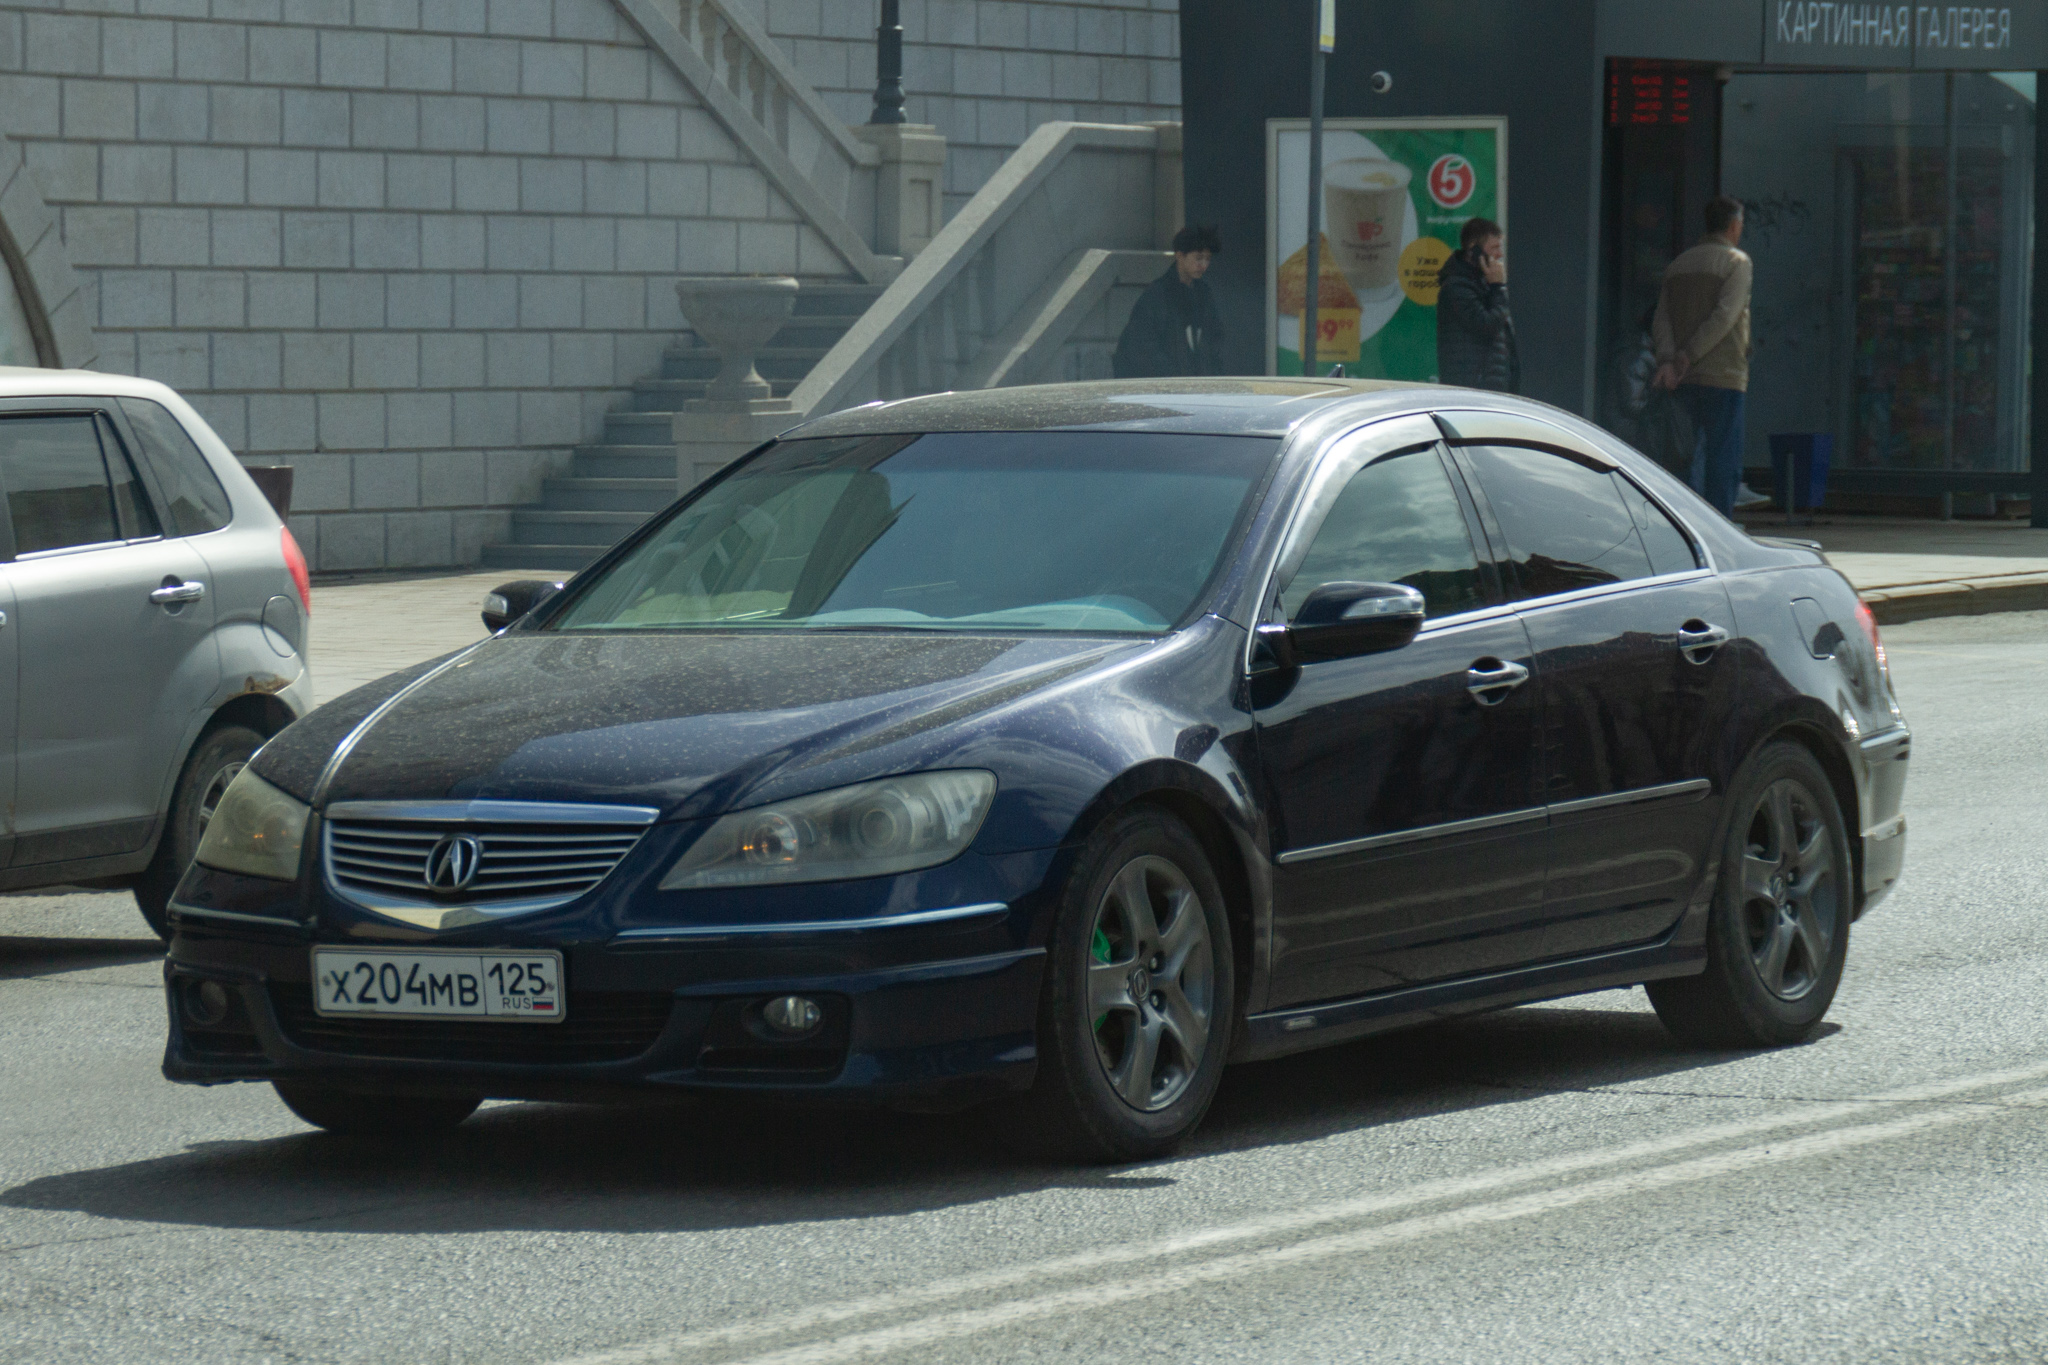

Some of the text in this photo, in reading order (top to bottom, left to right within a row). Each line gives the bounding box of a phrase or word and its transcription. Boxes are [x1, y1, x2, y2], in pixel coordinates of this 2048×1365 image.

[1776, 1, 2011, 49] КАРТИННАЯ ГАЛЕРЕЯ
[1440, 157, 1465, 198] 5
[1416, 256, 1439, 265] Уже
[329, 961, 547, 1007] Х204МВ 125
[502, 997, 532, 1010] RUS
